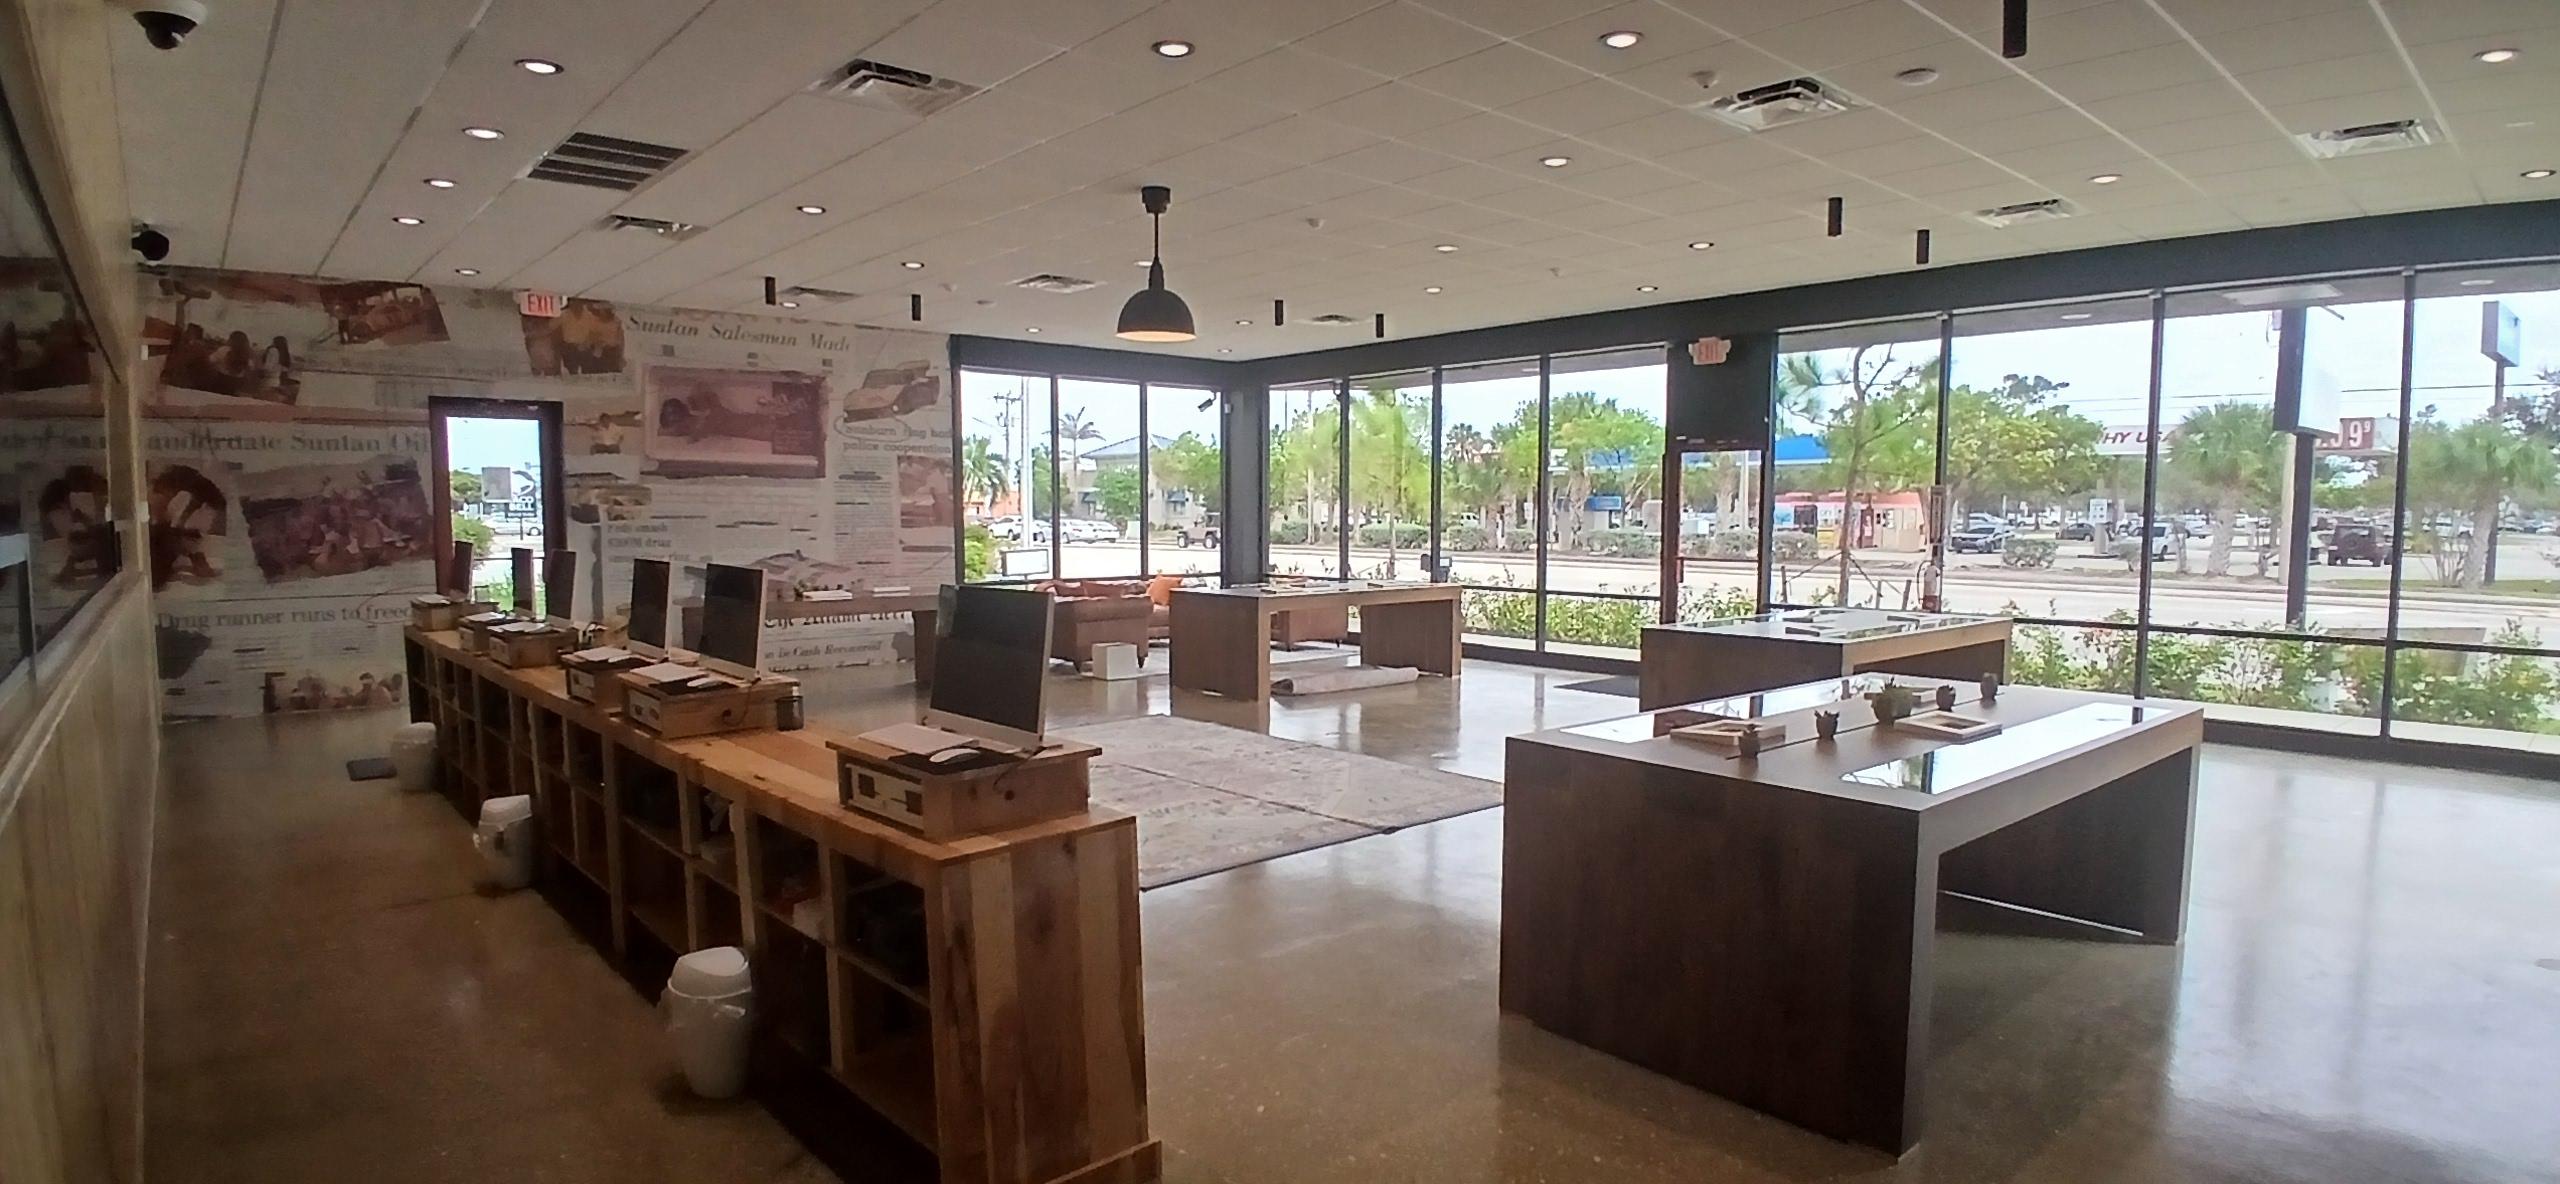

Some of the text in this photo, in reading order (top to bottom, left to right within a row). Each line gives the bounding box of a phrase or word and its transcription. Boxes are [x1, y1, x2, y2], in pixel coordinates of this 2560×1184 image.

[528, 294, 554, 314] EXIT
[626, 316, 699, 337] Suntan
[710, 324, 798, 347] Salesman
[1698, 341, 1720, 361] EXIT
[290, 433, 381, 452] Suntan
[842, 441, 951, 455] police cooperation
[157, 611, 210, 630] Drug
[216, 611, 284, 627] runner
[290, 608, 337, 624] runs
[342, 606, 361, 621] to
